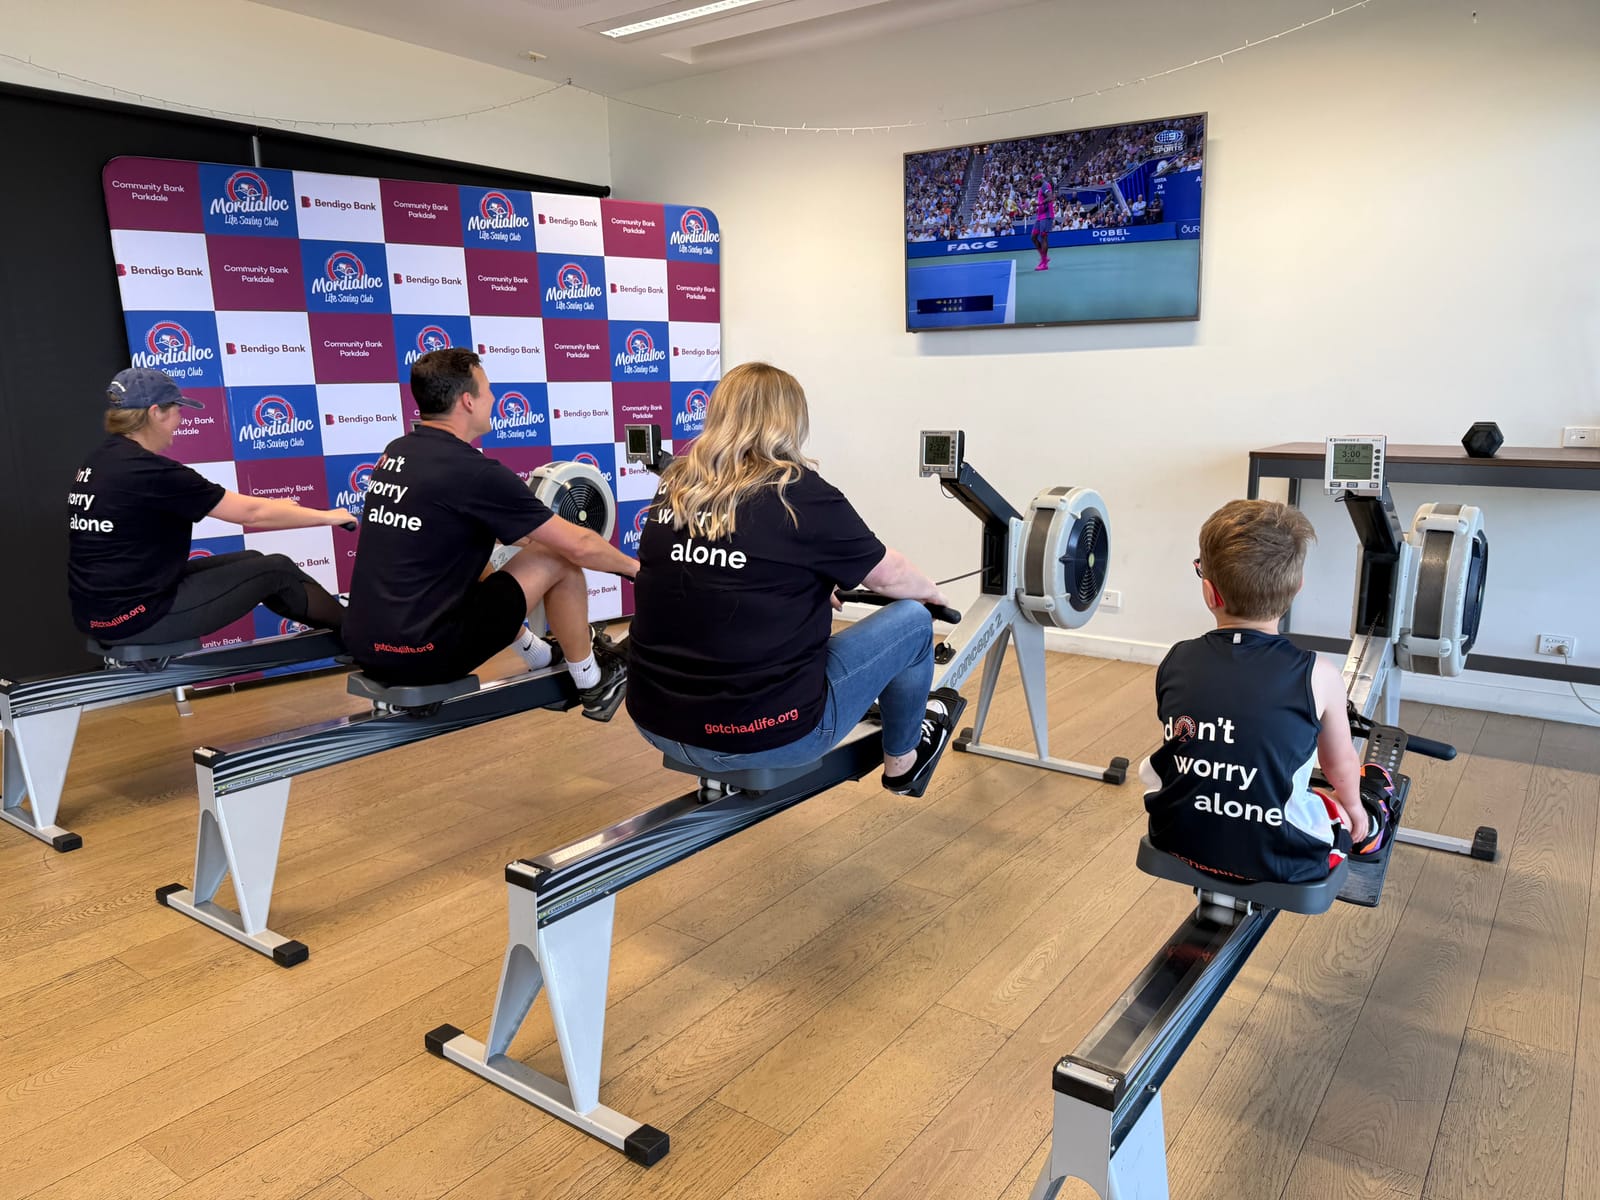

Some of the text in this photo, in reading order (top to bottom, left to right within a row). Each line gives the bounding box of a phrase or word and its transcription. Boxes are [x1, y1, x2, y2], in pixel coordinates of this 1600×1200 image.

[112, 180, 184, 193] Community Bank
[132, 192, 168, 202] Parkdale
[210, 197, 289, 215] Mordialloc
[315, 199, 376, 210] Bendigo Bank
[394, 201, 430, 212] Community
[225, 215, 279, 227] Life Saving Club
[408, 211, 436, 220] Parkdale
[468, 215, 528, 231] Mordialloc
[549, 216, 597, 227] Bendigo Bank
[611, 218, 641, 228] Community
[479, 230, 521, 242] Life Saving Club
[670, 230, 720, 245] Mordialloc
[1093, 228, 1130, 237] DOBEL
[679, 244, 713, 255] Life Saving Club
[131, 266, 203, 277] Bendigo Bank
[224, 265, 289, 275] Community Bank
[241, 275, 274, 284] Parkdale
[312, 275, 383, 294] Mordialloc
[406, 275, 462, 285] Bendigo Bank
[478, 275, 511, 284] Community
[546, 285, 602, 302] Mordialloc
[620, 285, 646, 295] Bendigo
[676, 285, 702, 293] Community
[325, 293, 373, 304] Life Saving Club
[556, 300, 594, 311] Life Saving Club
[240, 344, 305, 355] Bendigo Bank
[324, 341, 364, 350] Community
[489, 345, 518, 355] Bendigo
[554, 343, 584, 352] Community
[132, 346, 213, 369] Mordialloc
[615, 349, 665, 366] Mordialloc
[682, 348, 705, 357] Bendigo
[187, 367, 203, 376] Club
[624, 364, 658, 374] Life Saving Club
[338, 414, 397, 425] Bendigo Bank
[564, 410, 591, 418] Bendigo
[172, 428, 199, 436] arkdale
[239, 419, 314, 442] Mordialloc
[497, 428, 537, 439] Life Saving Club
[253, 438, 304, 450] Life Saving Club
[252, 484, 314, 496] Community Bank
[70, 513, 114, 532] alone
[369, 505, 422, 531] alone
[671, 539, 747, 569] alone
[307, 557, 329, 567] Bank
[588, 585, 617, 596] digo Bank
[223, 636, 242, 645] Bank
[704, 708, 799, 734] gotcha4life.org
[1164, 715, 1235, 744] don't
[1174, 754, 1258, 791] worry
[1194, 792, 1283, 827] alone
